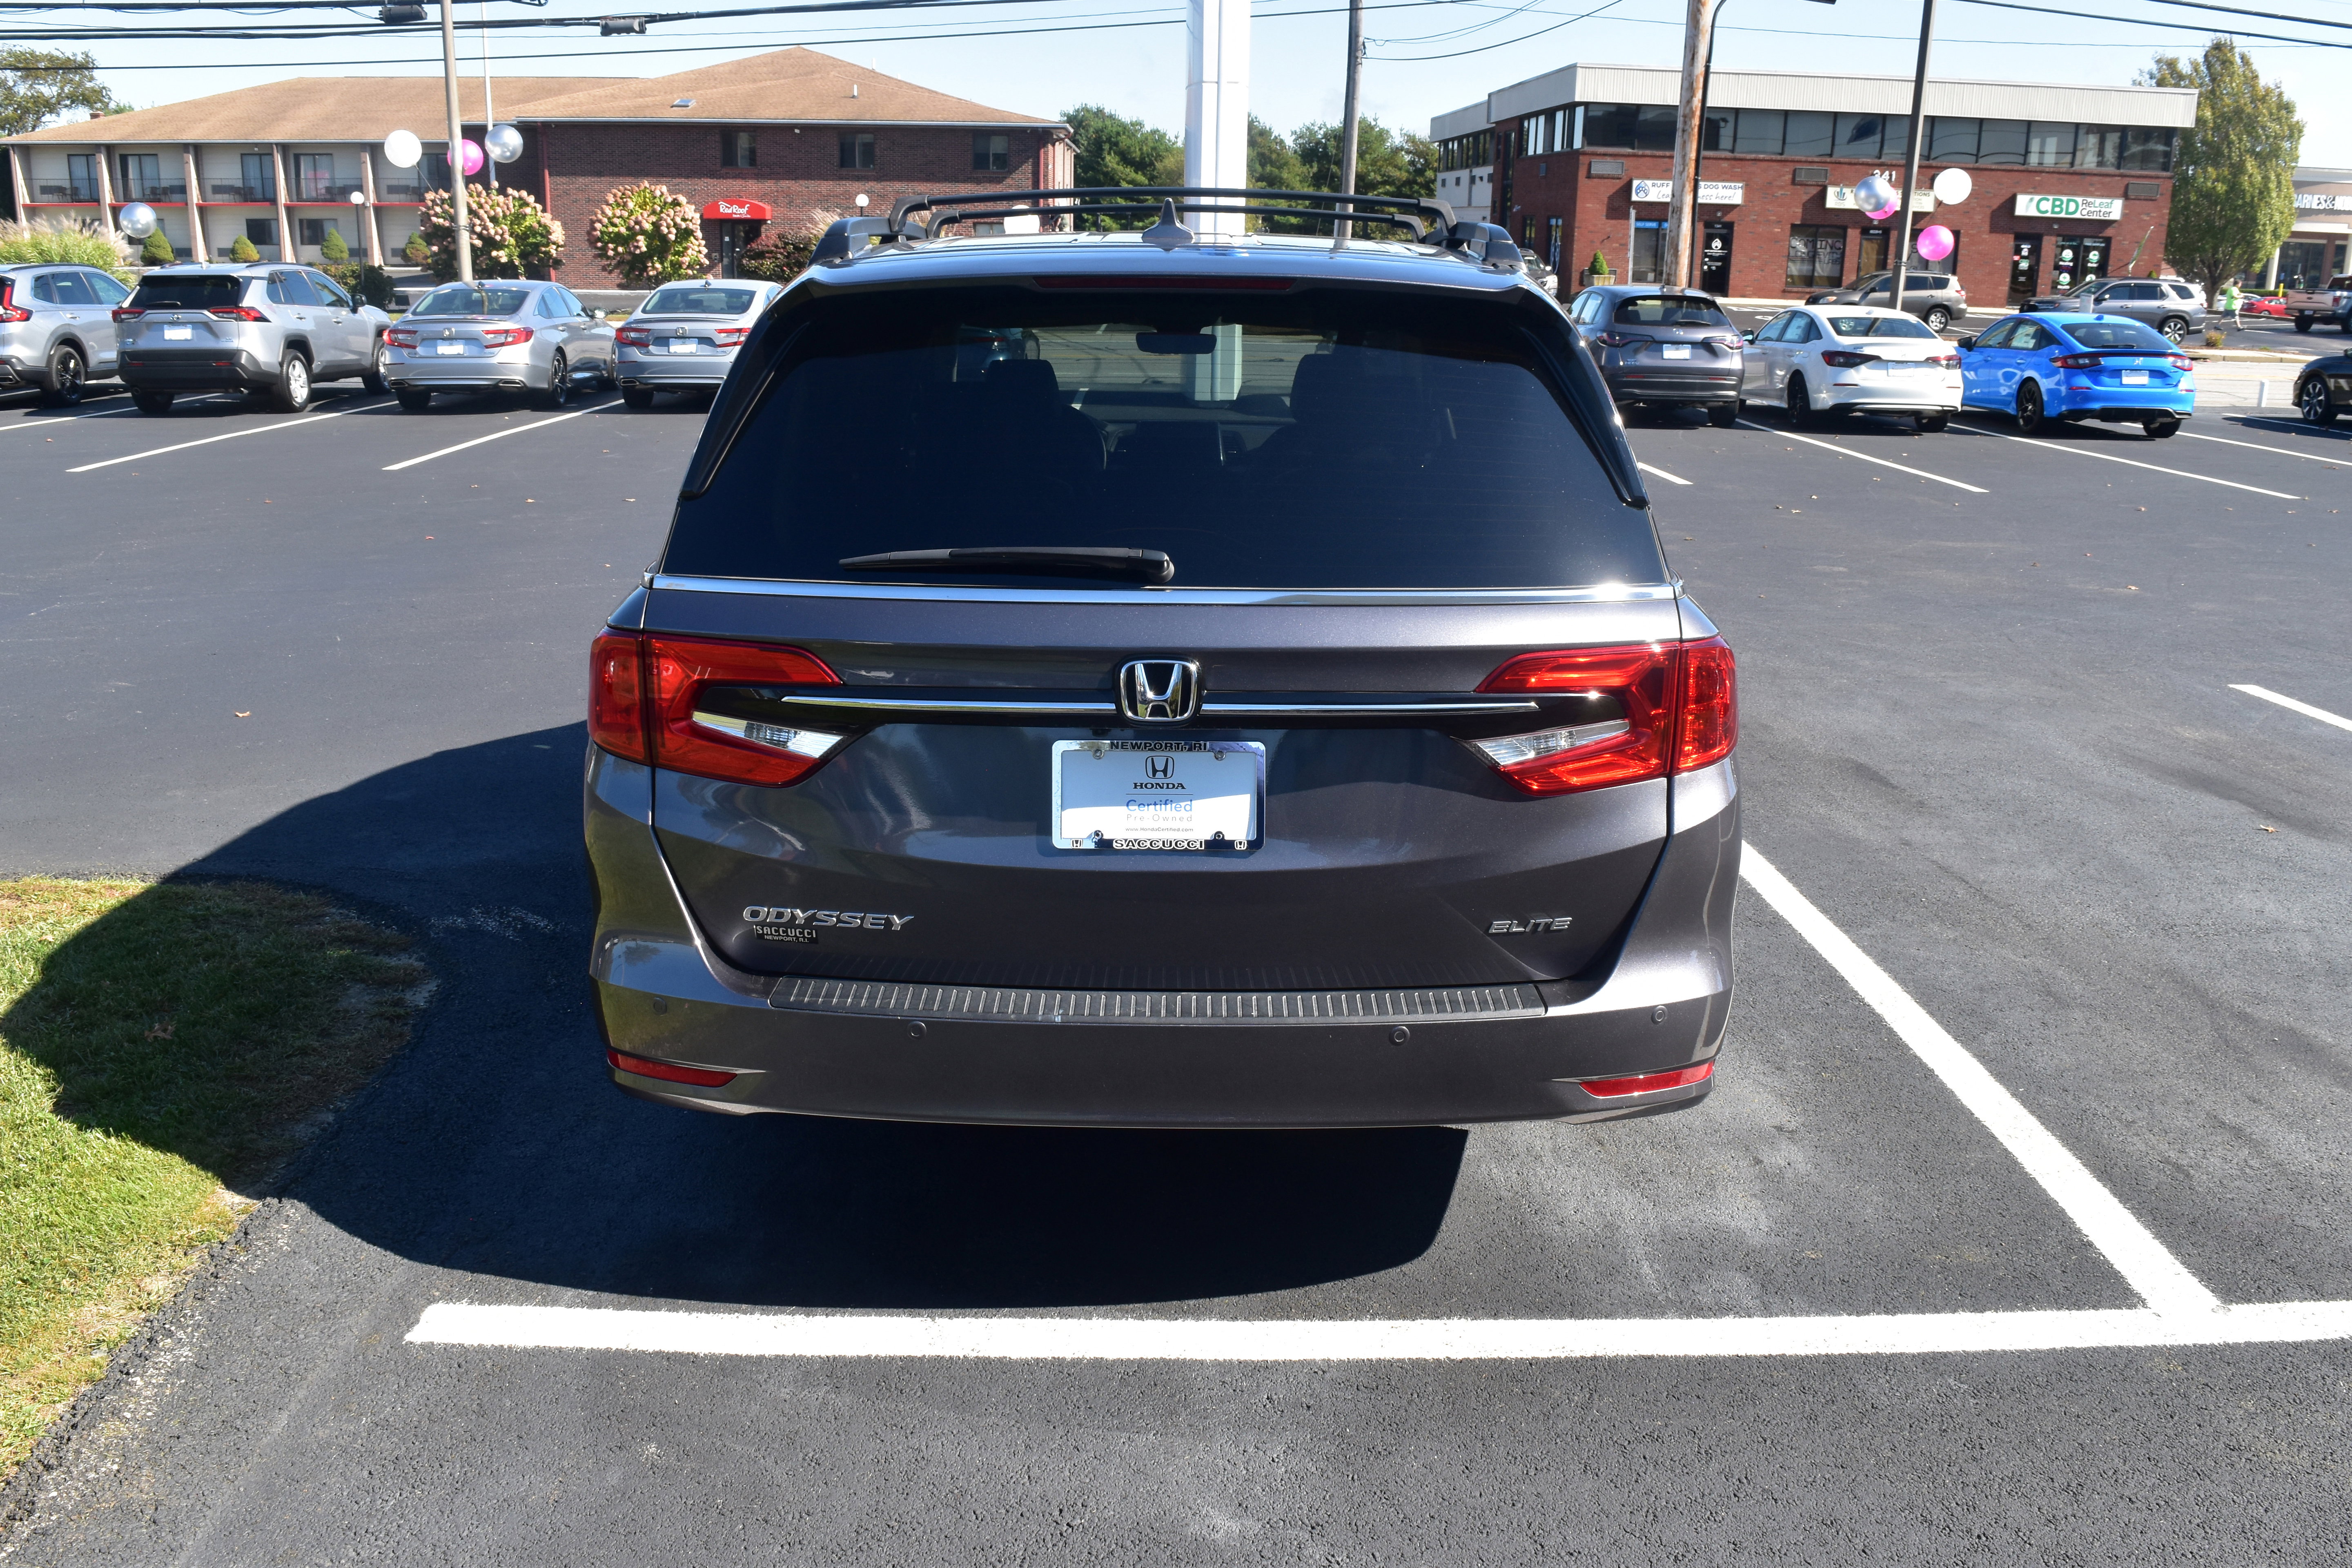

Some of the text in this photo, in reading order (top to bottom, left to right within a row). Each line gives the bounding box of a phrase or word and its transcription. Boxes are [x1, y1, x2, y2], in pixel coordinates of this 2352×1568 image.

[1657, 190, 1670, 199] Lea
[1715, 192, 1735, 200] here!
[719, 204, 750, 214] Red Roof
[2036, 197, 2114, 216] CBD ReLeaf
[2334, 196, 2352, 211] NOB
[2080, 208, 2113, 218] Center
[1110, 741, 1208, 751] NEWPORT, RI
[1126, 799, 1192, 812] Certified
[1113, 838, 1205, 850] SACCUCCI
[743, 905, 914, 931] ODYSSEY
[1488, 917, 1572, 933] ELITE
[756, 925, 816, 938] SACCUCCI
